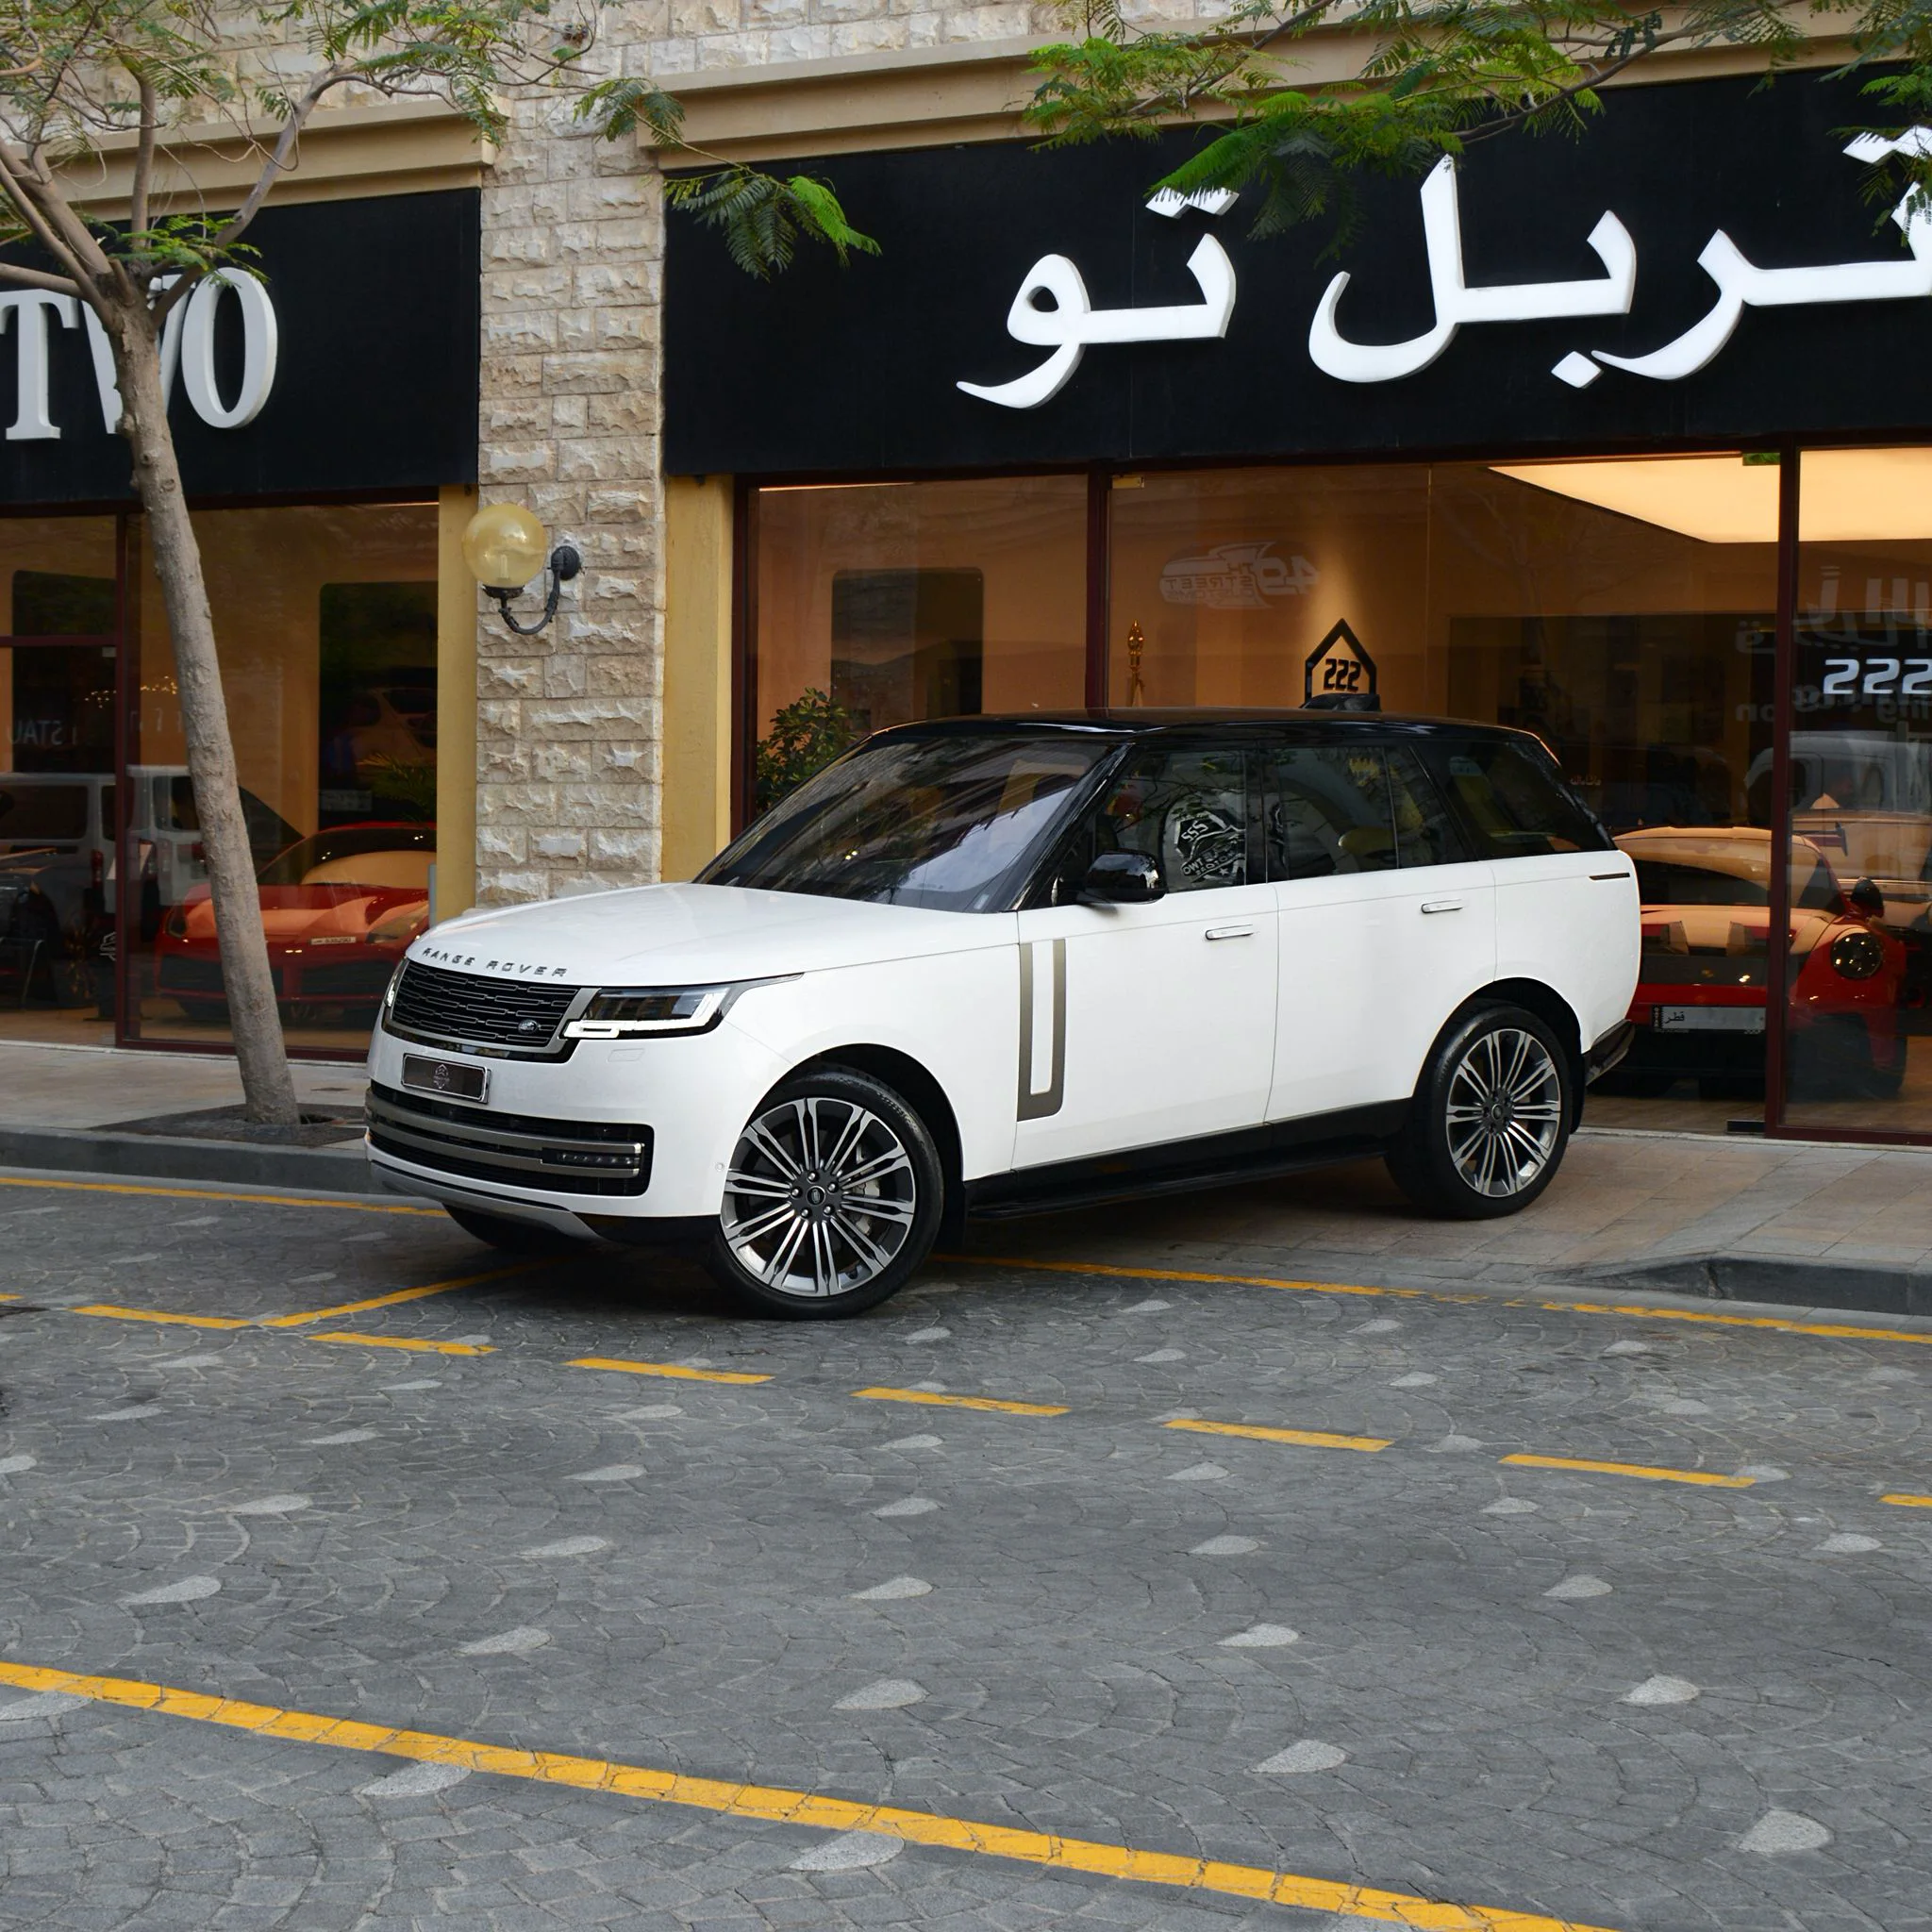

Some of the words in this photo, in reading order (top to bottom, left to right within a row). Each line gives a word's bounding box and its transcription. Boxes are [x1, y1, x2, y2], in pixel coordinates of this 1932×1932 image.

[1324, 658, 1361, 692] 222
[1823, 658, 1932, 695] 222
[422, 947, 475, 967] RANGE
[486, 959, 568, 977] ROVER
